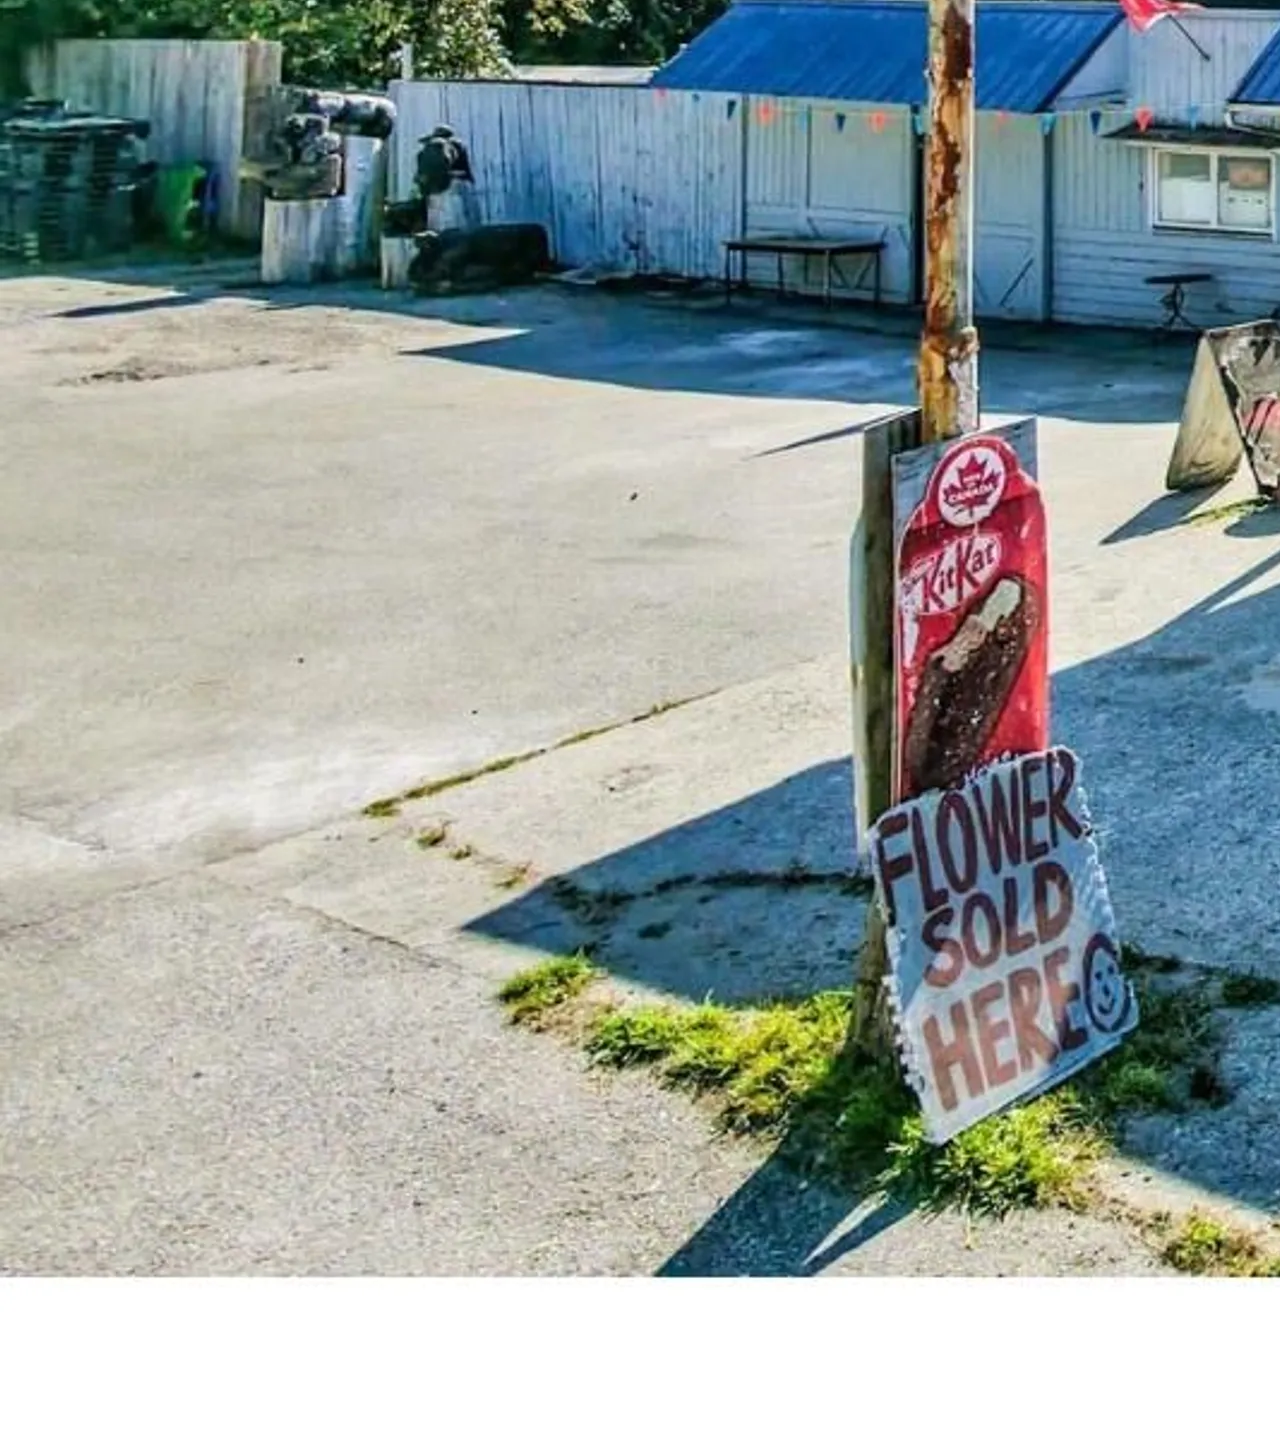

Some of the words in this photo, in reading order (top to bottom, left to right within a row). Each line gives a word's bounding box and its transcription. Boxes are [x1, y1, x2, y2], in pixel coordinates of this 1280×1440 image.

[875, 748, 1085, 927] FLOWER
[921, 860, 1074, 989] SOLD
[922, 947, 1089, 1112] HERE
